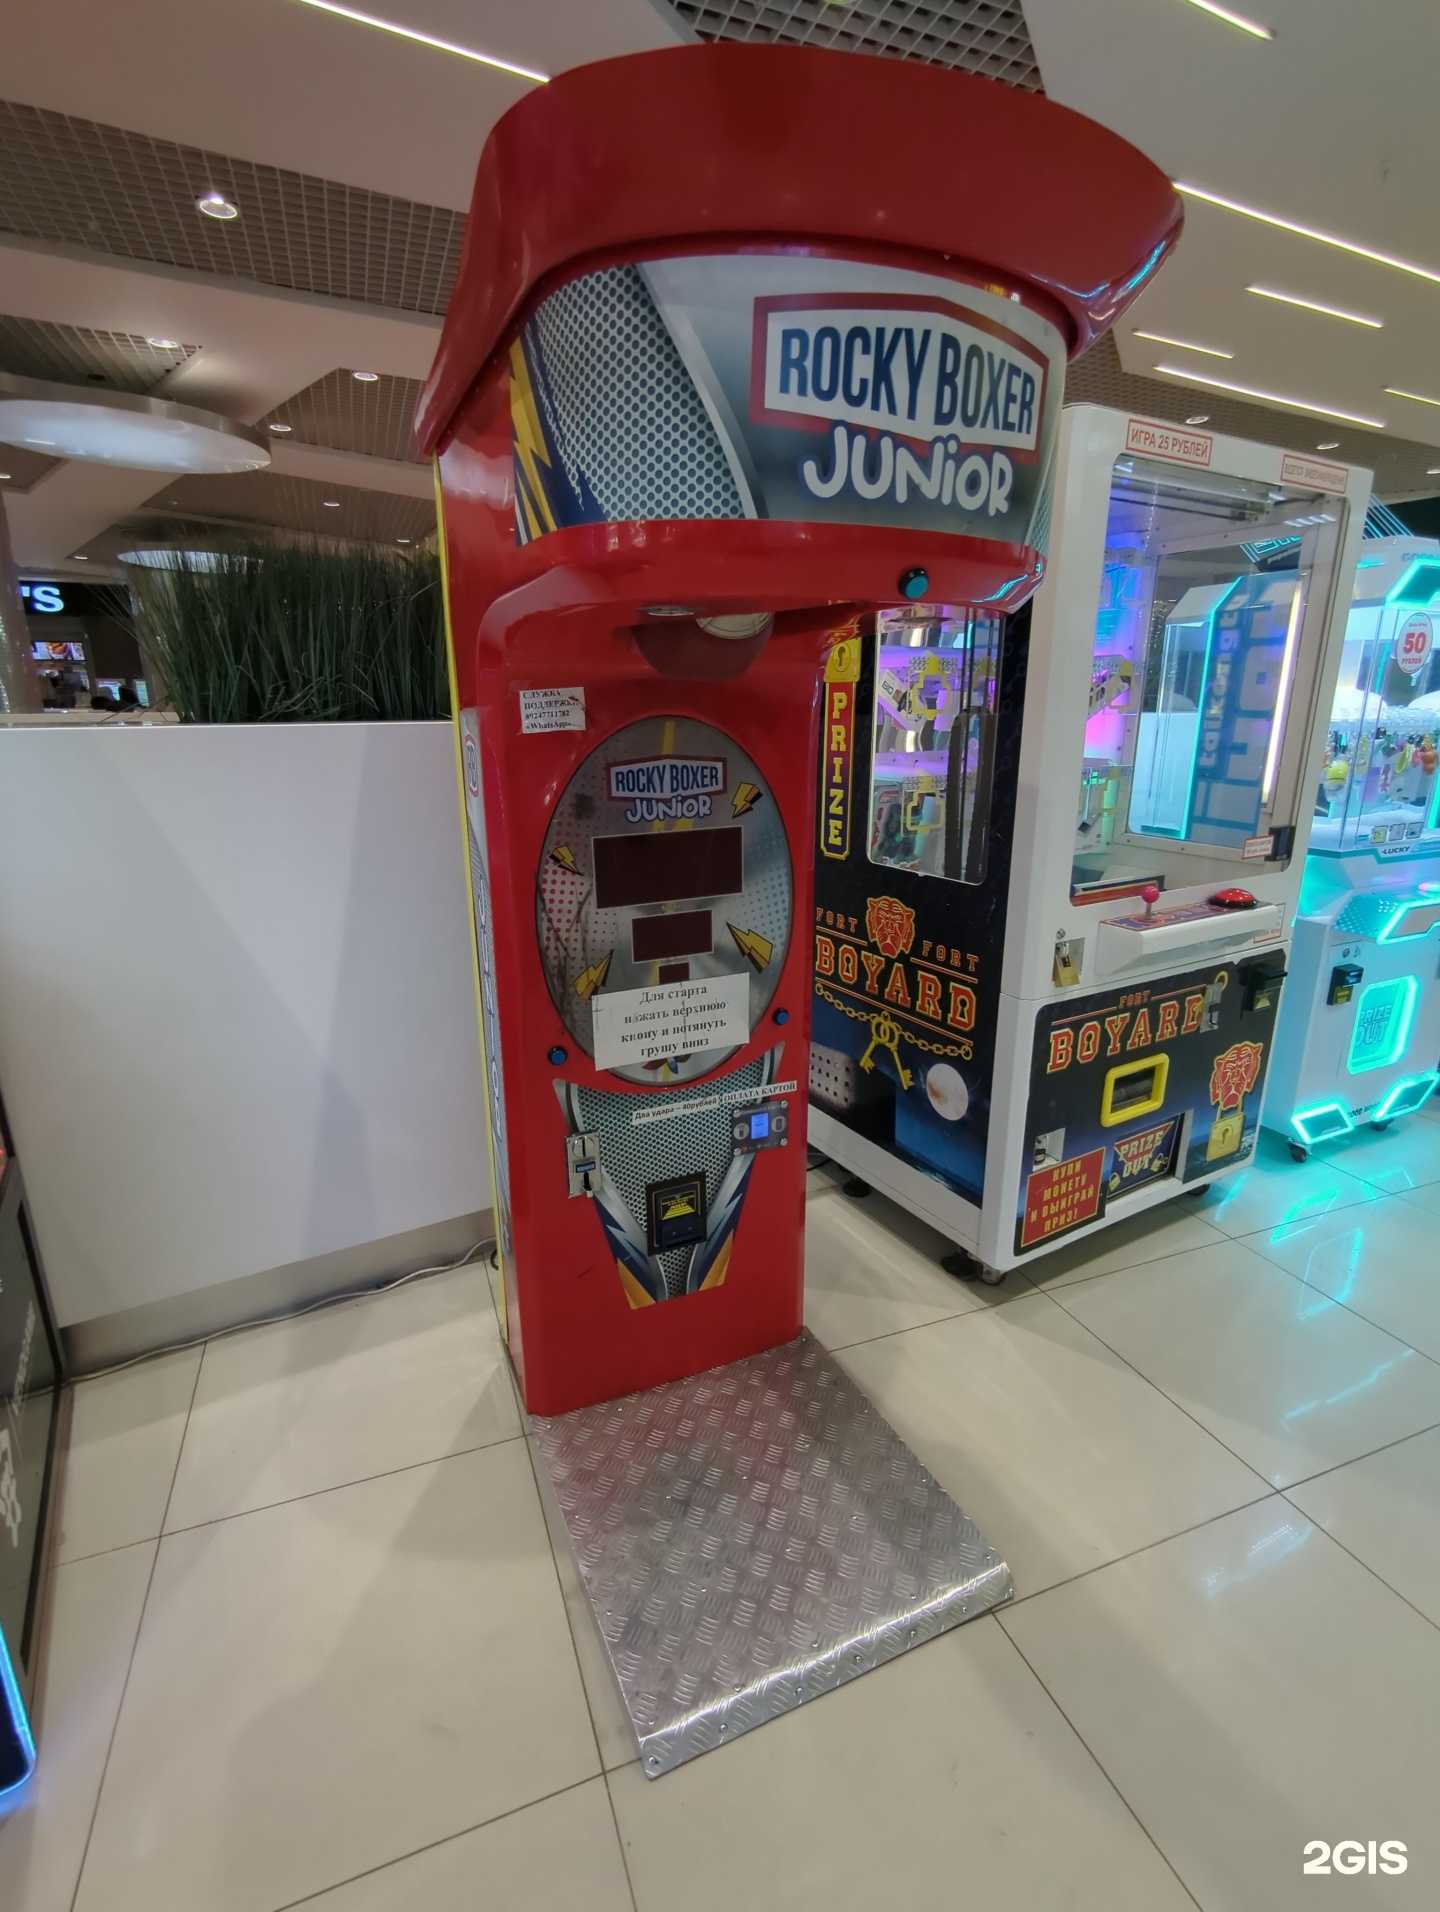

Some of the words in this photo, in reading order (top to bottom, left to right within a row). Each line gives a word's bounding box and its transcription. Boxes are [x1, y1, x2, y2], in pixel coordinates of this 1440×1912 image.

[779, 325, 932, 421] ROCKY
[934, 332, 1036, 435] BOXER
[1131, 428, 1156, 447] ИГРА
[1158, 436, 1169, 449] 25
[1171, 438, 1208, 458] РУБЛЕЙ
[1403, 632, 1427, 654] 50
[615, 764, 667, 793] ROCKY
[670, 764, 719, 792] BOXER
[827, 692, 848, 846] PRIZE
[1382, 846, 1411, 855] LUCKY
[815, 906, 859, 933] FORT
[921, 939, 980, 972] FORT
[815, 934, 977, 1032] BOYARD
[640, 991, 664, 1005] Для
[667, 985, 708, 1000] старта
[1119, 989, 1152, 1009] FORT
[672, 1000, 727, 1018] верхнюю
[661, 1027, 669, 1036] и
[672, 1018, 727, 1034] потянуть
[640, 1042, 679, 1058] грушу
[682, 1037, 710, 1049] вниз
[723, 1089, 759, 1101] ОПЛАТА
[634, 1111, 651, 1121] Два
[651, 1106, 675, 1118] удара
[1119, 1130, 1164, 1160] PRIZE
[1122, 1153, 1152, 1178] OUT
